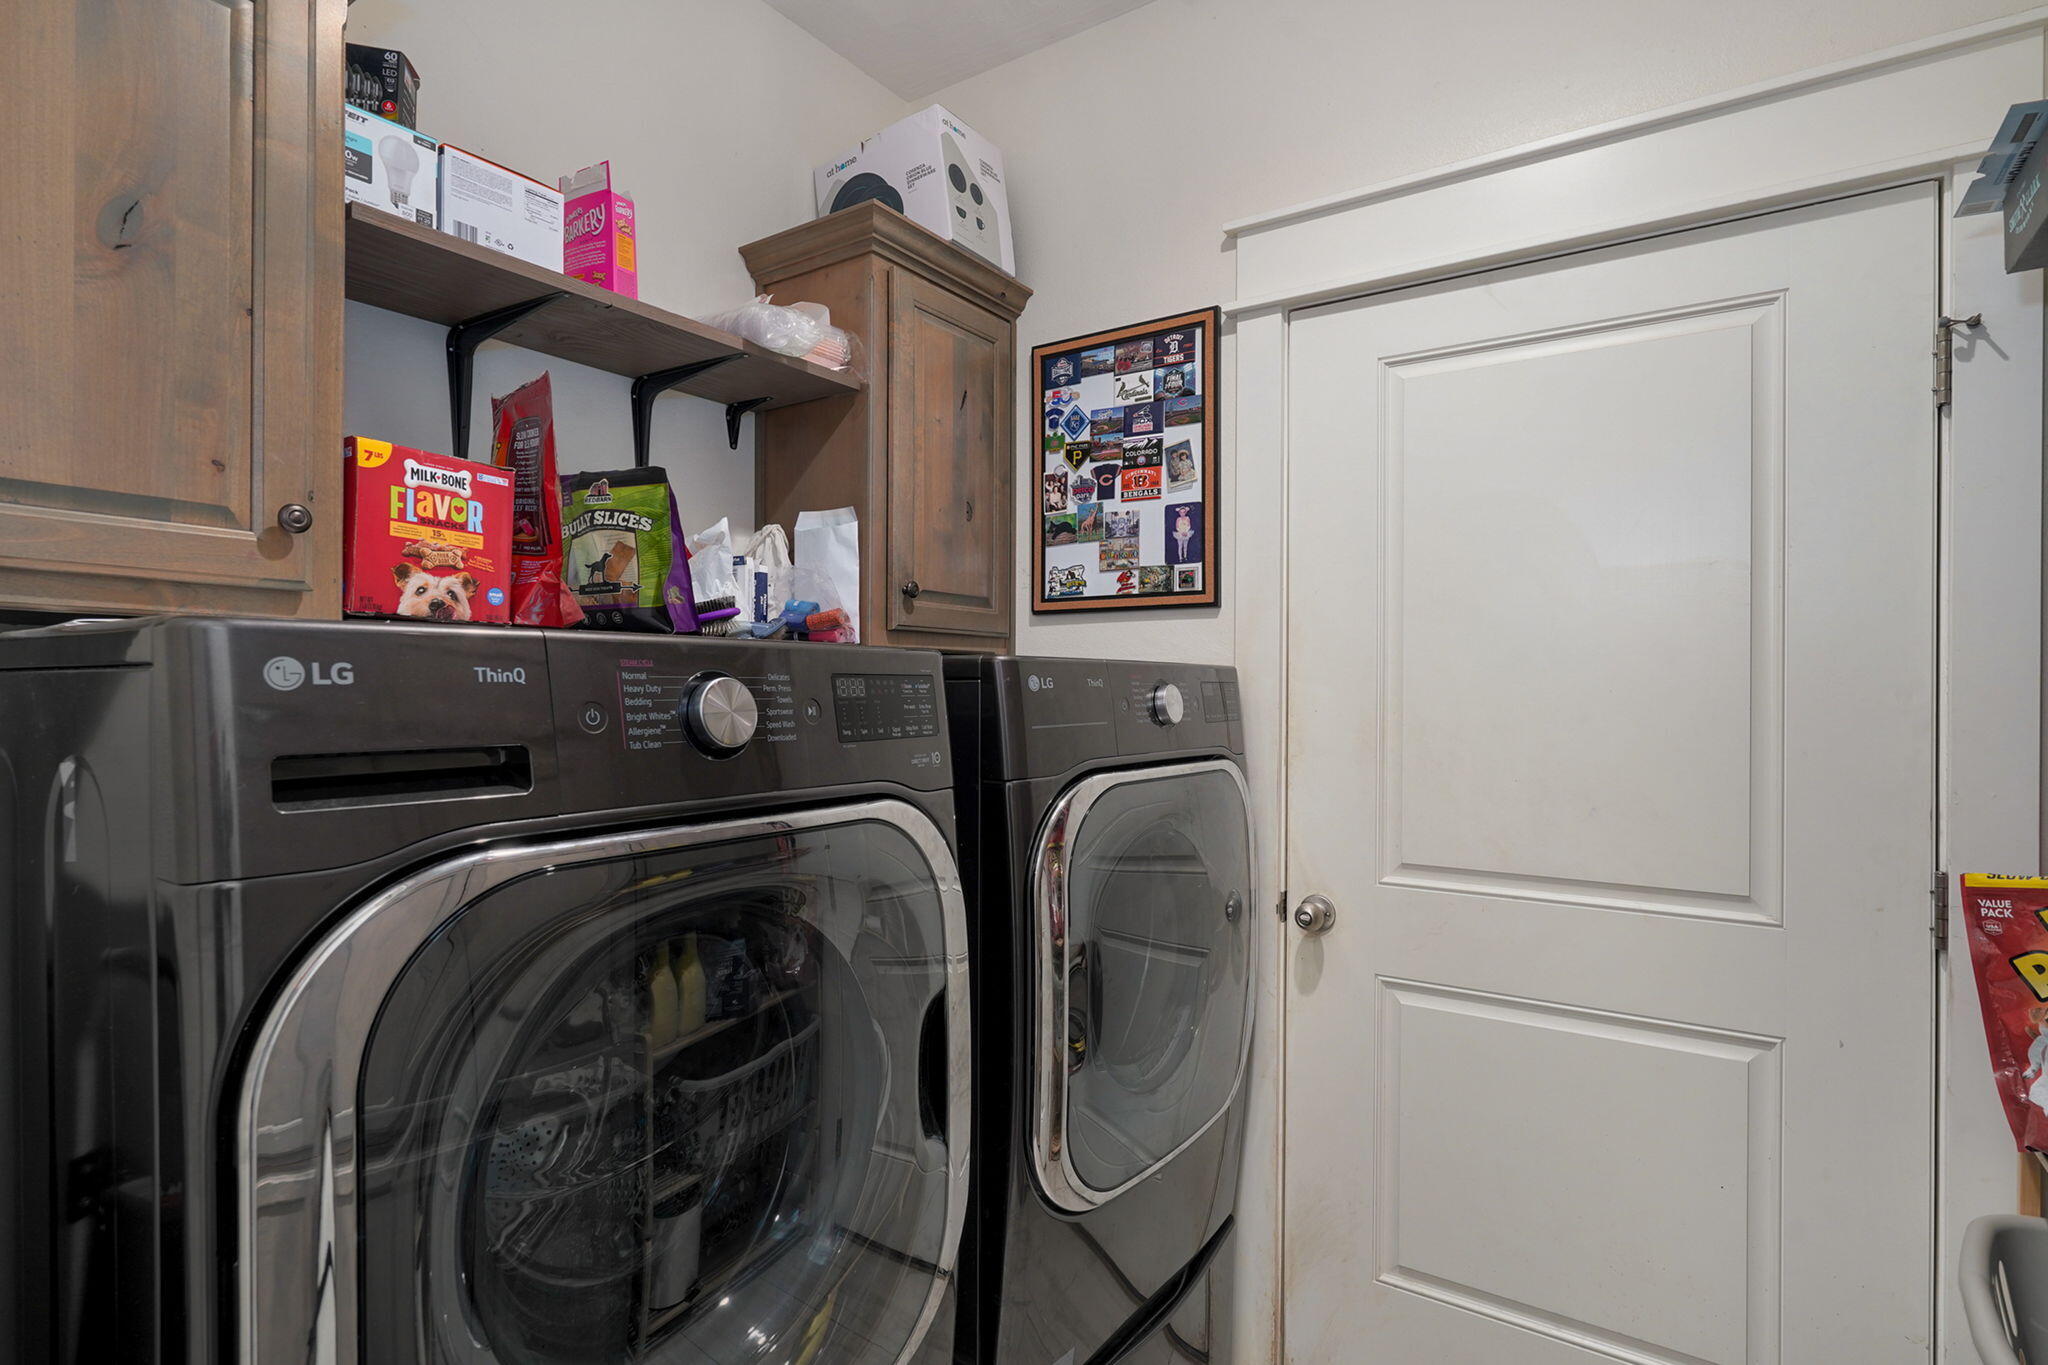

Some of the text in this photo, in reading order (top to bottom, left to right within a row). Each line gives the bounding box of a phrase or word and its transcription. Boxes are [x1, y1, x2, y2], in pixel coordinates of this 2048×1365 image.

[384, 51, 397, 60] 60
[382, 68, 398, 77] LED
[835, 156, 857, 173] home
[1163, 334, 1184, 344] DETROIT
[1163, 353, 1184, 364] TIGERS
[363, 450, 373, 462] 7
[1125, 448, 1158, 457] COLORADO
[1123, 488, 1158, 498] BENGALS
[420, 518, 466, 531] SNACKS
[562, 513, 592, 539] BULLY
[594, 511, 653, 532] SLICES
[312, 662, 354, 685] LG
[474, 666, 526, 684] ThinQ
[622, 672, 647, 680] Normal
[1041, 677, 1054, 689] LG
[1087, 678, 1104, 688] ThinQ
[623, 684, 661, 694] Heavy Duty
[624, 697, 652, 707] Bedding
[626, 713, 647, 722] Bright
[766, 721, 782, 730] Speed
[630, 740, 662, 750] Tub Clean
[1977, 899, 2012, 908] VALUE
[1980, 908, 2014, 919] PACK
